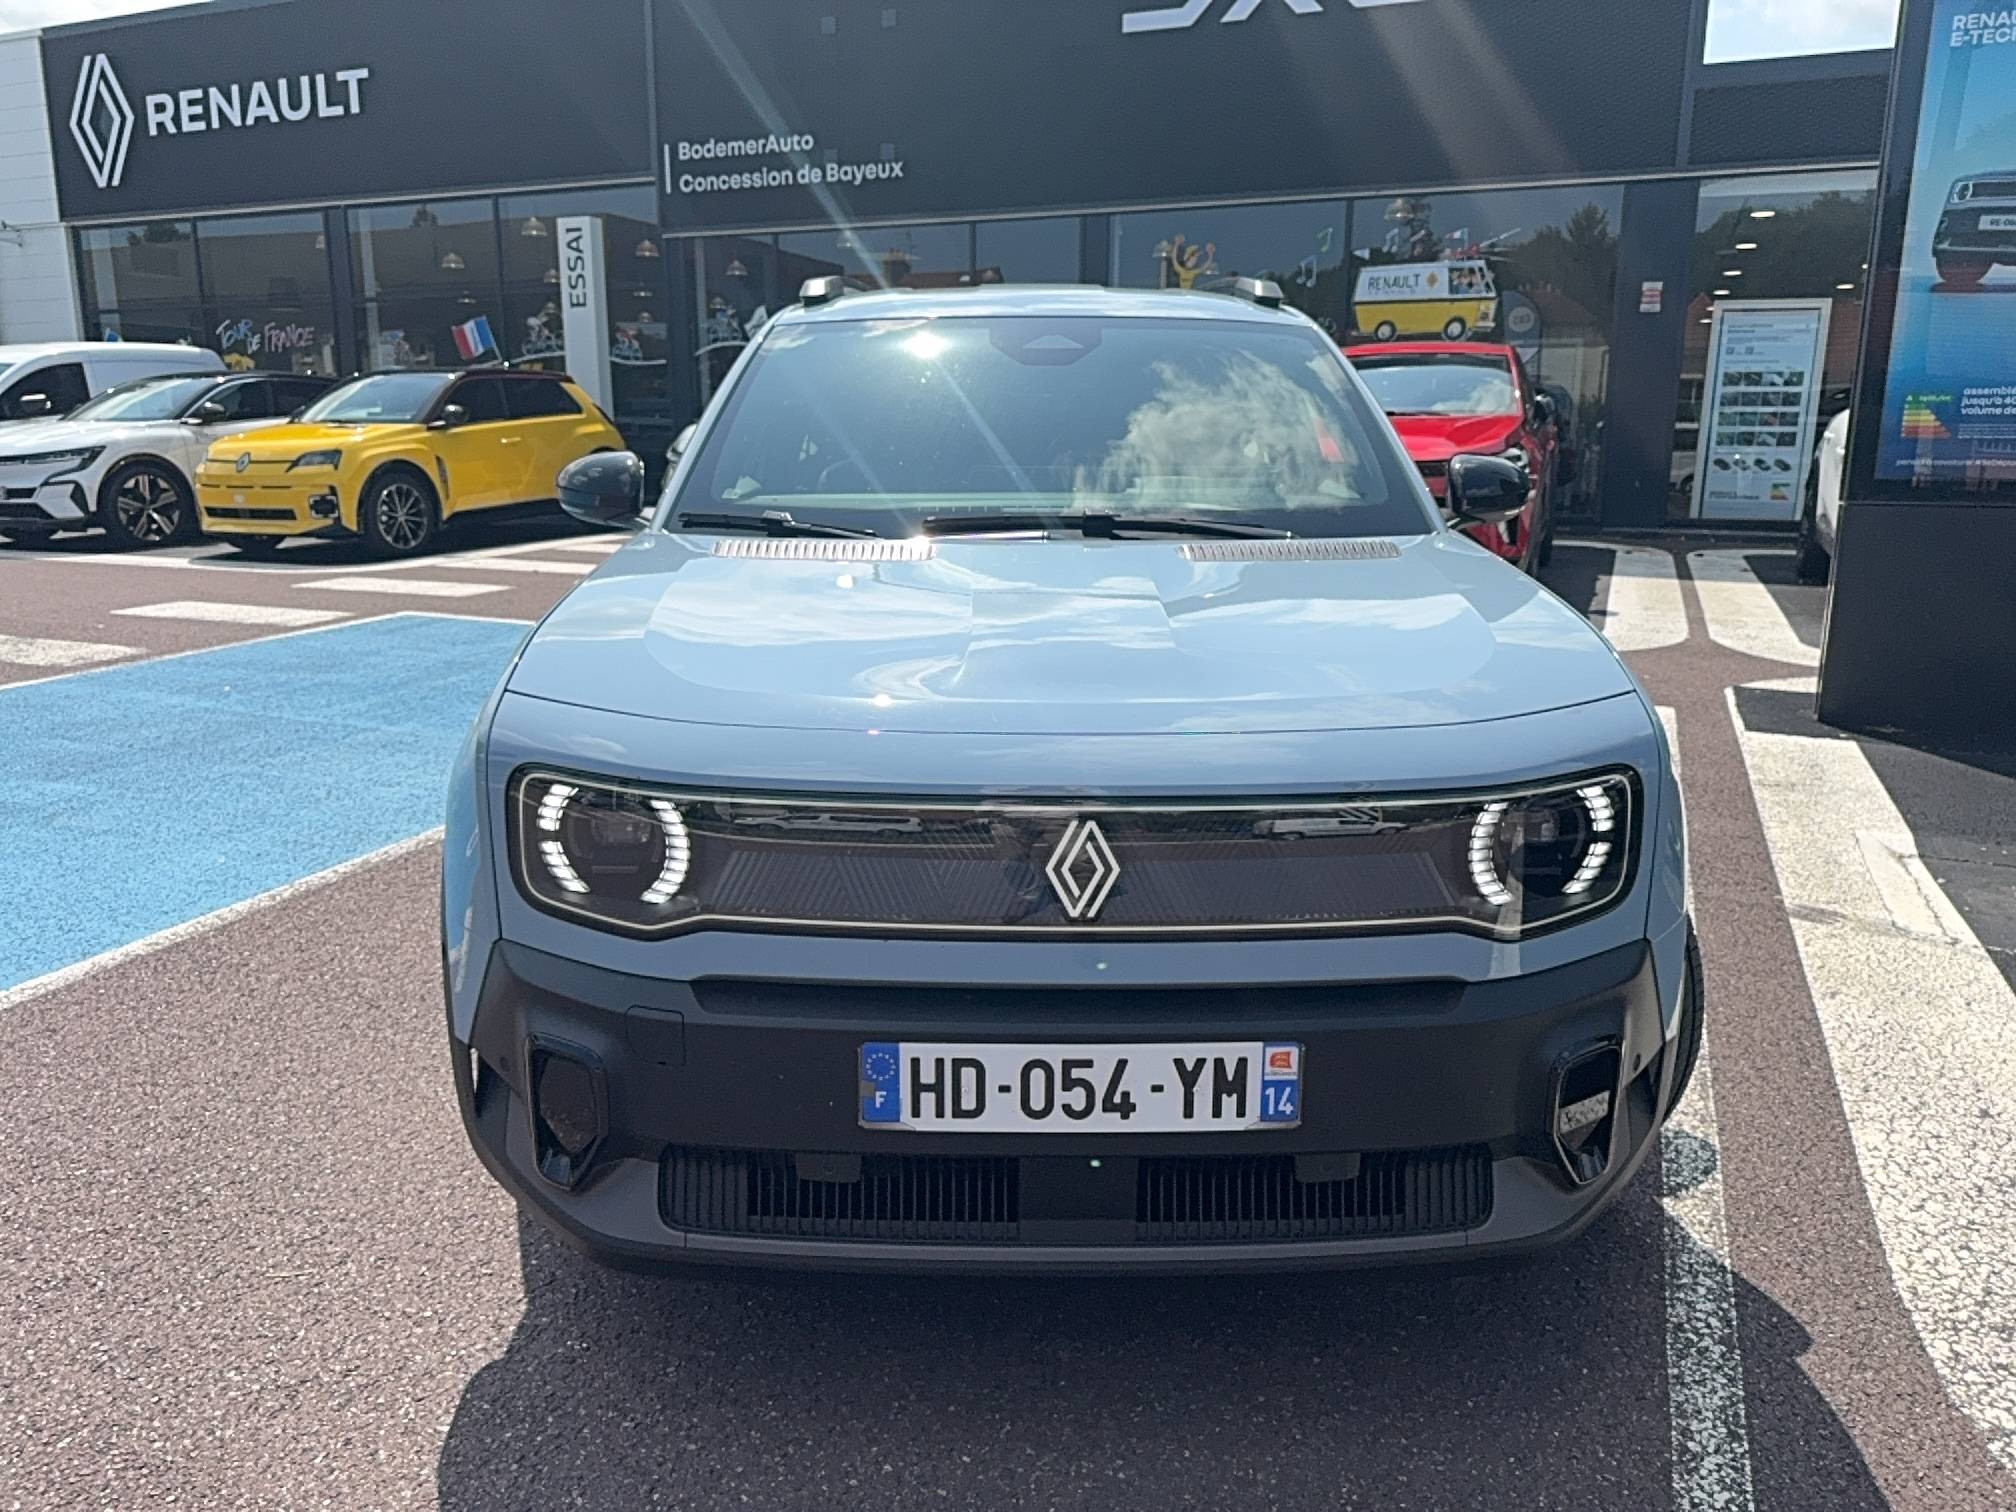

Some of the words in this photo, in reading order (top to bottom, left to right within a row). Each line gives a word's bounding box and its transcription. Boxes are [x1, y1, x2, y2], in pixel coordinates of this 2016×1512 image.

[145, 67, 369, 137] RENAULT
[677, 133, 815, 161] BodemerAuto
[679, 167, 794, 194] Concession
[797, 163, 822, 185] de
[825, 160, 904, 186] Bayeux
[566, 227, 587, 308] ESSAI
[1367, 273, 1421, 291] RENAULT
[264, 321, 315, 353] FRANCE
[874, 1090, 888, 1109] F
[909, 1056, 1249, 1121] HD-054-YM
[1265, 1086, 1295, 1116] 14
